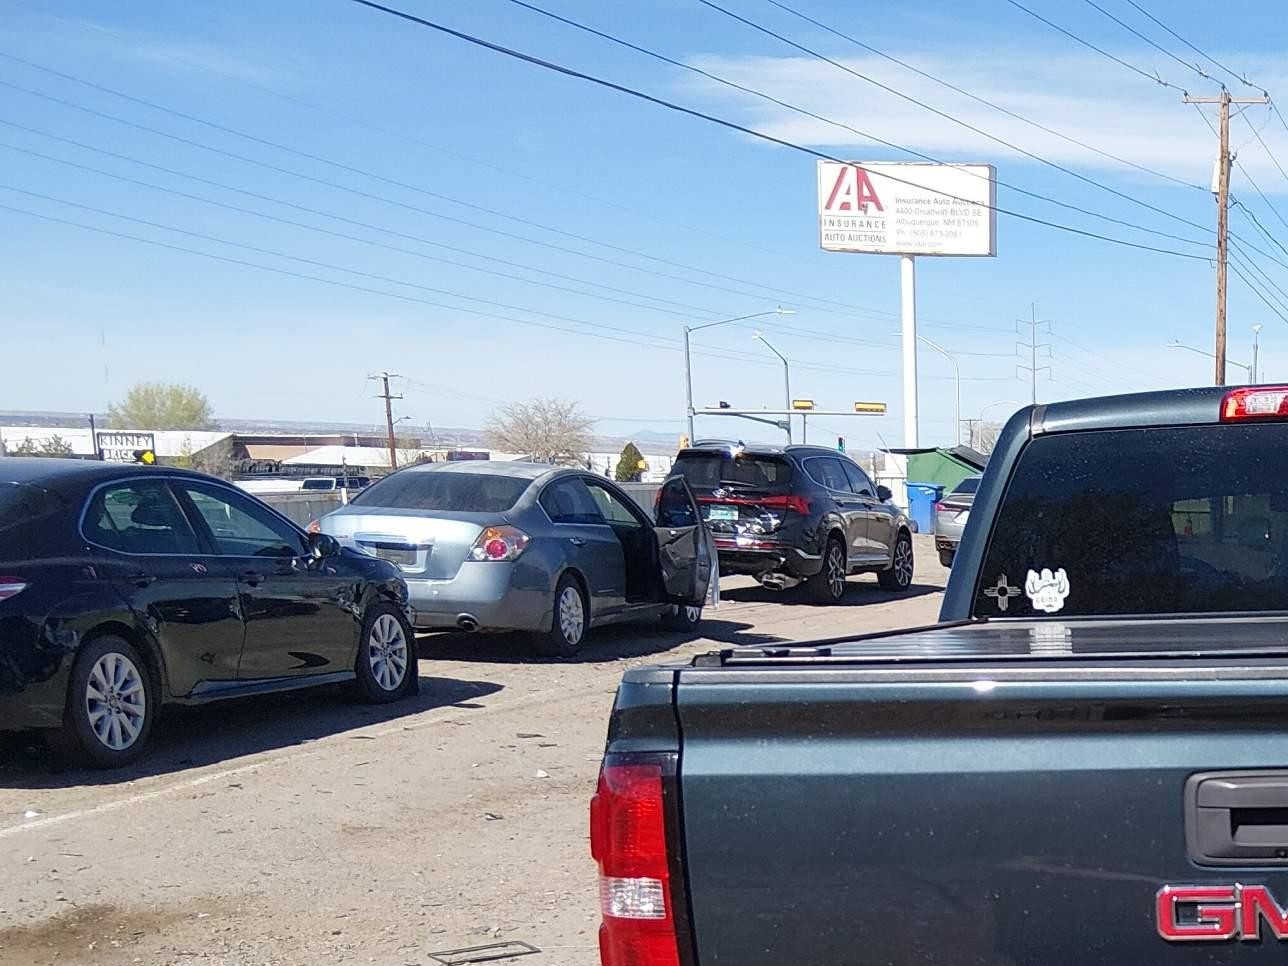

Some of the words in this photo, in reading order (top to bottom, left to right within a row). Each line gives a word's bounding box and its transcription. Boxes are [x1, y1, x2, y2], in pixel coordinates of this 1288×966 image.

[895, 197, 931, 205] Insurance
[933, 198, 951, 206] Auto
[896, 208, 913, 216] 4400
[823, 218, 886, 229] INSURANCE
[824, 232, 846, 242] AUTO
[847, 233, 887, 243] AUCTIONS
[100, 434, 150, 447] KINNEY
[103, 449, 137, 460] BRICK
